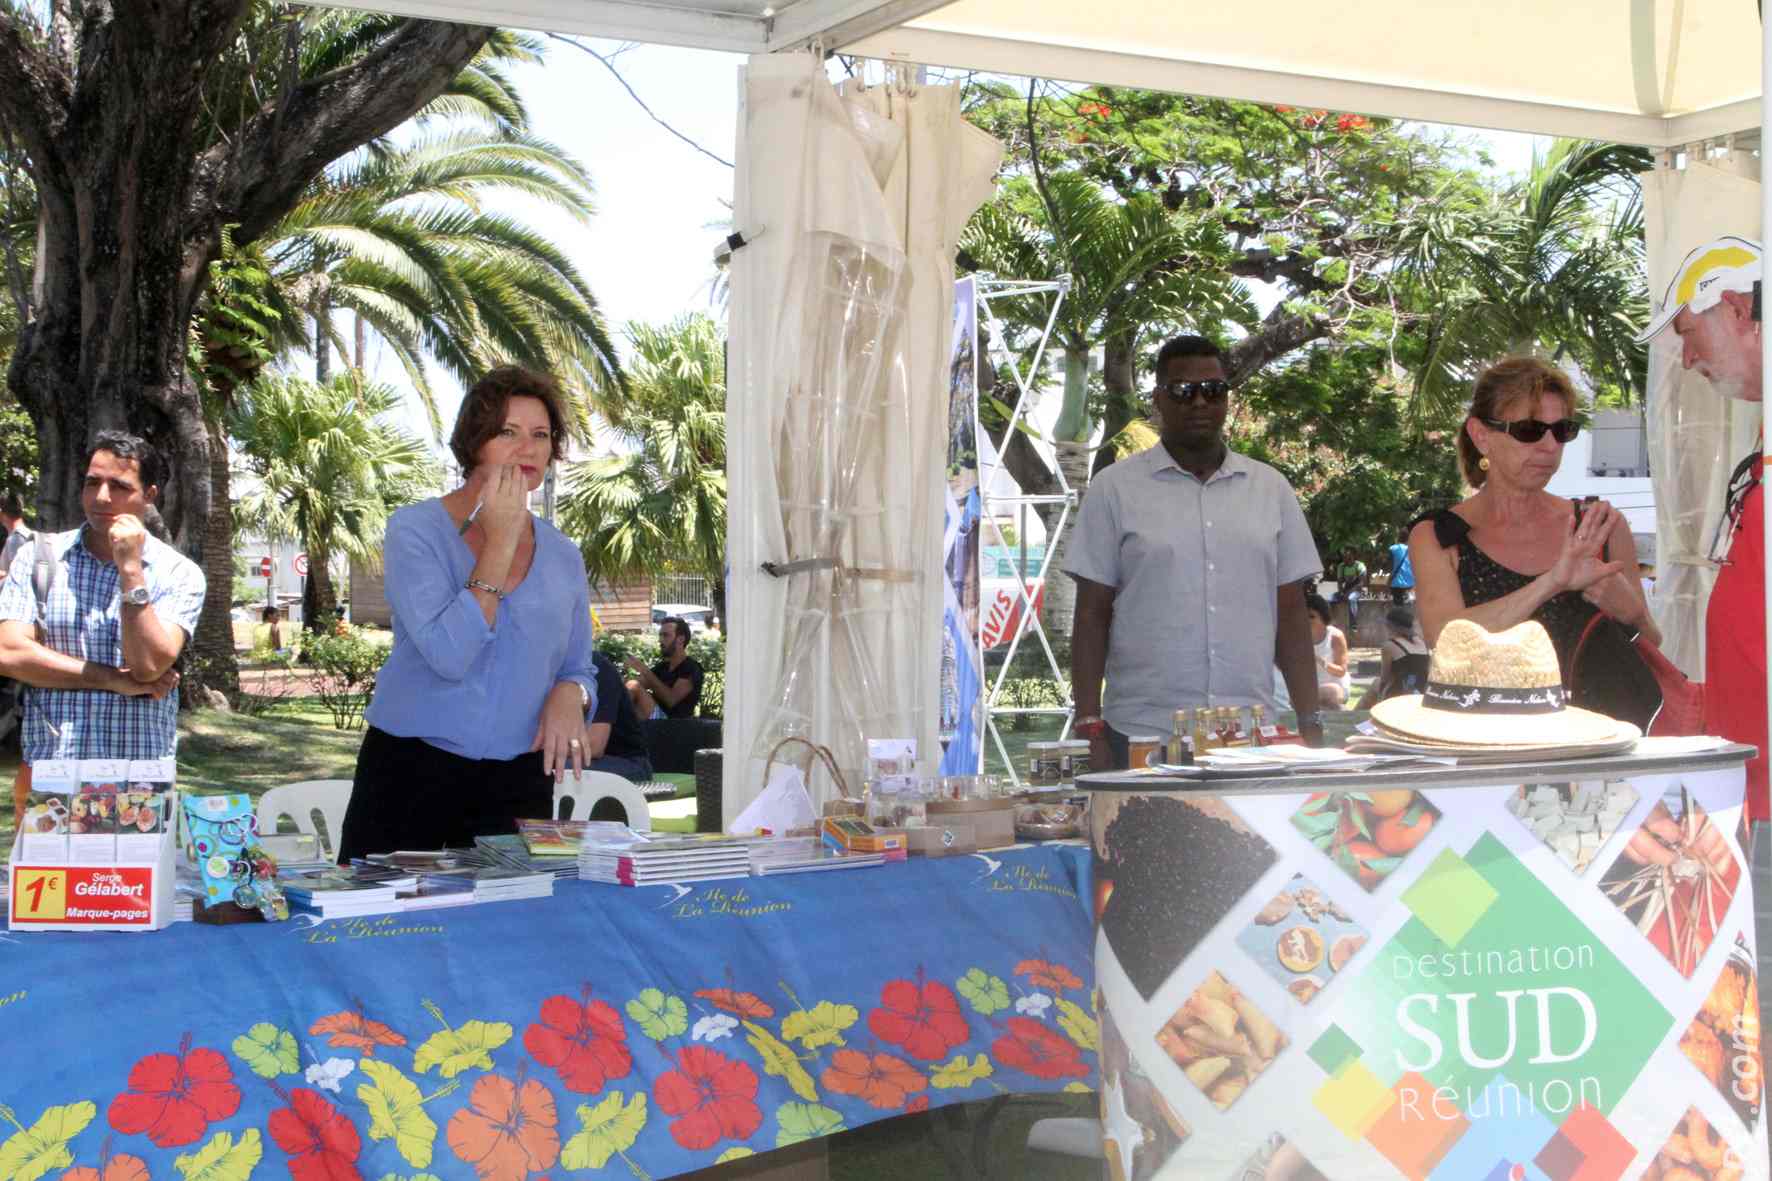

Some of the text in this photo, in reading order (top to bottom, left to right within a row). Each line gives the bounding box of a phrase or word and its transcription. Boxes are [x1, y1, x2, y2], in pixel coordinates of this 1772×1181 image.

[981, 588, 1011, 649] AVIS
[75, 881, 144, 896] Gélabert
[66, 907, 149, 920] Marque-pages
[1392, 943, 1595, 979] Destination
[1393, 985, 1599, 1073] SUD
[1399, 1074, 1602, 1122] Réunion
